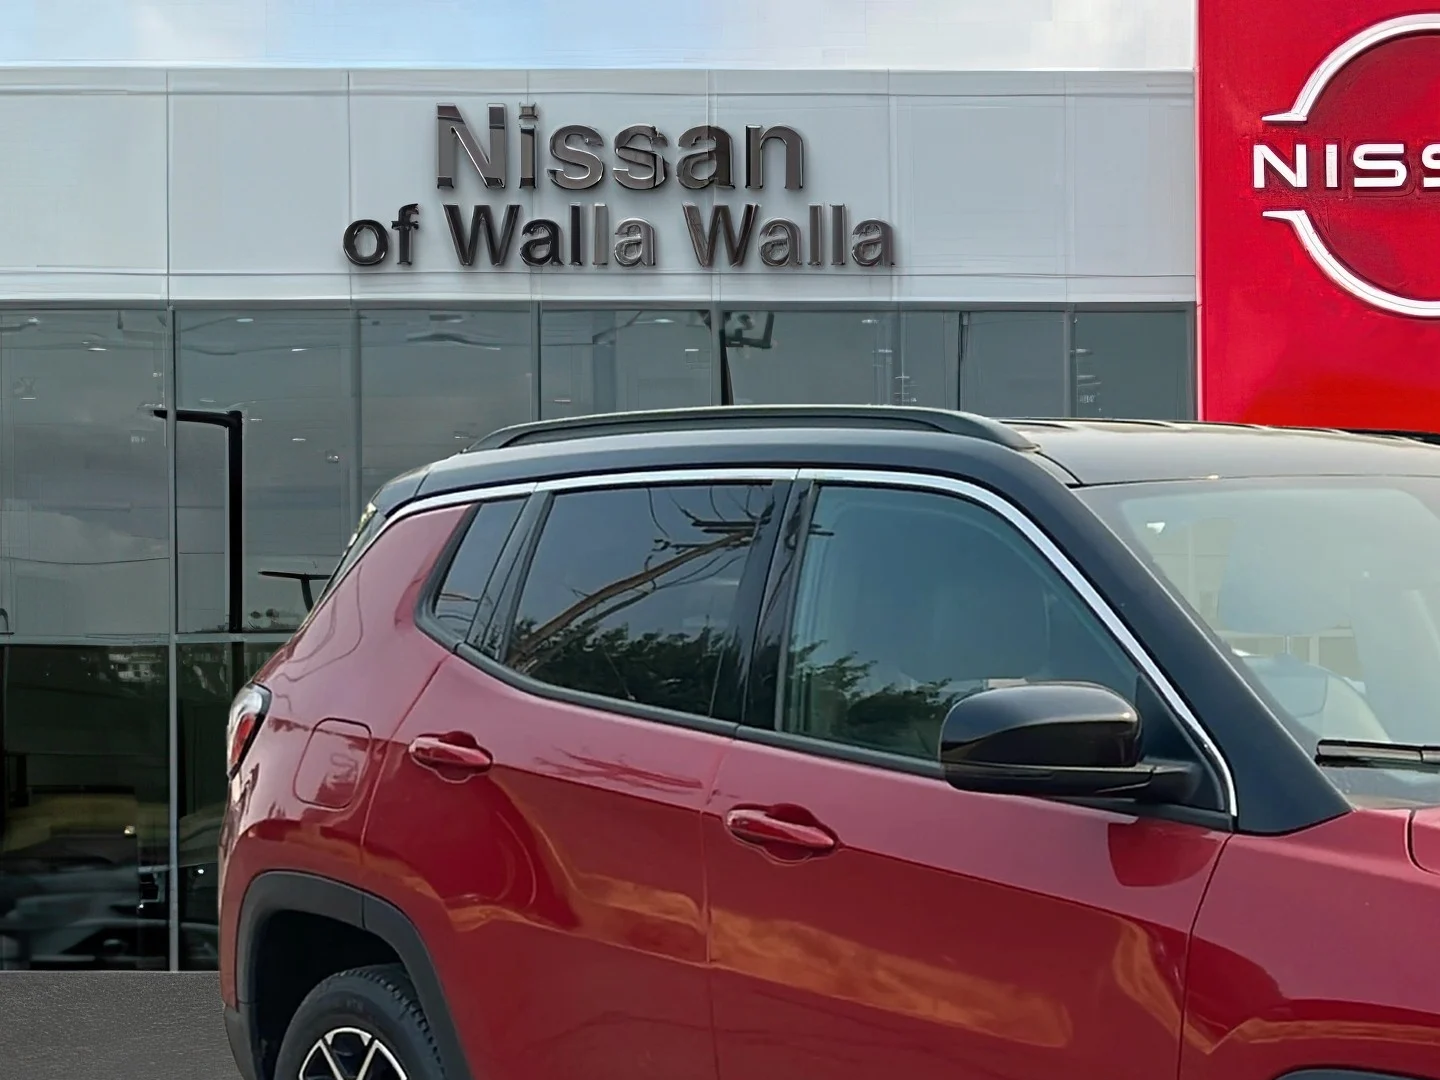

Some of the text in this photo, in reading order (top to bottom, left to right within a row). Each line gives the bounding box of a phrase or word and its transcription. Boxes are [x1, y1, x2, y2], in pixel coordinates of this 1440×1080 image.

[436, 101, 804, 190] Nissan
[342, 202, 895, 267] of Walla Walla
